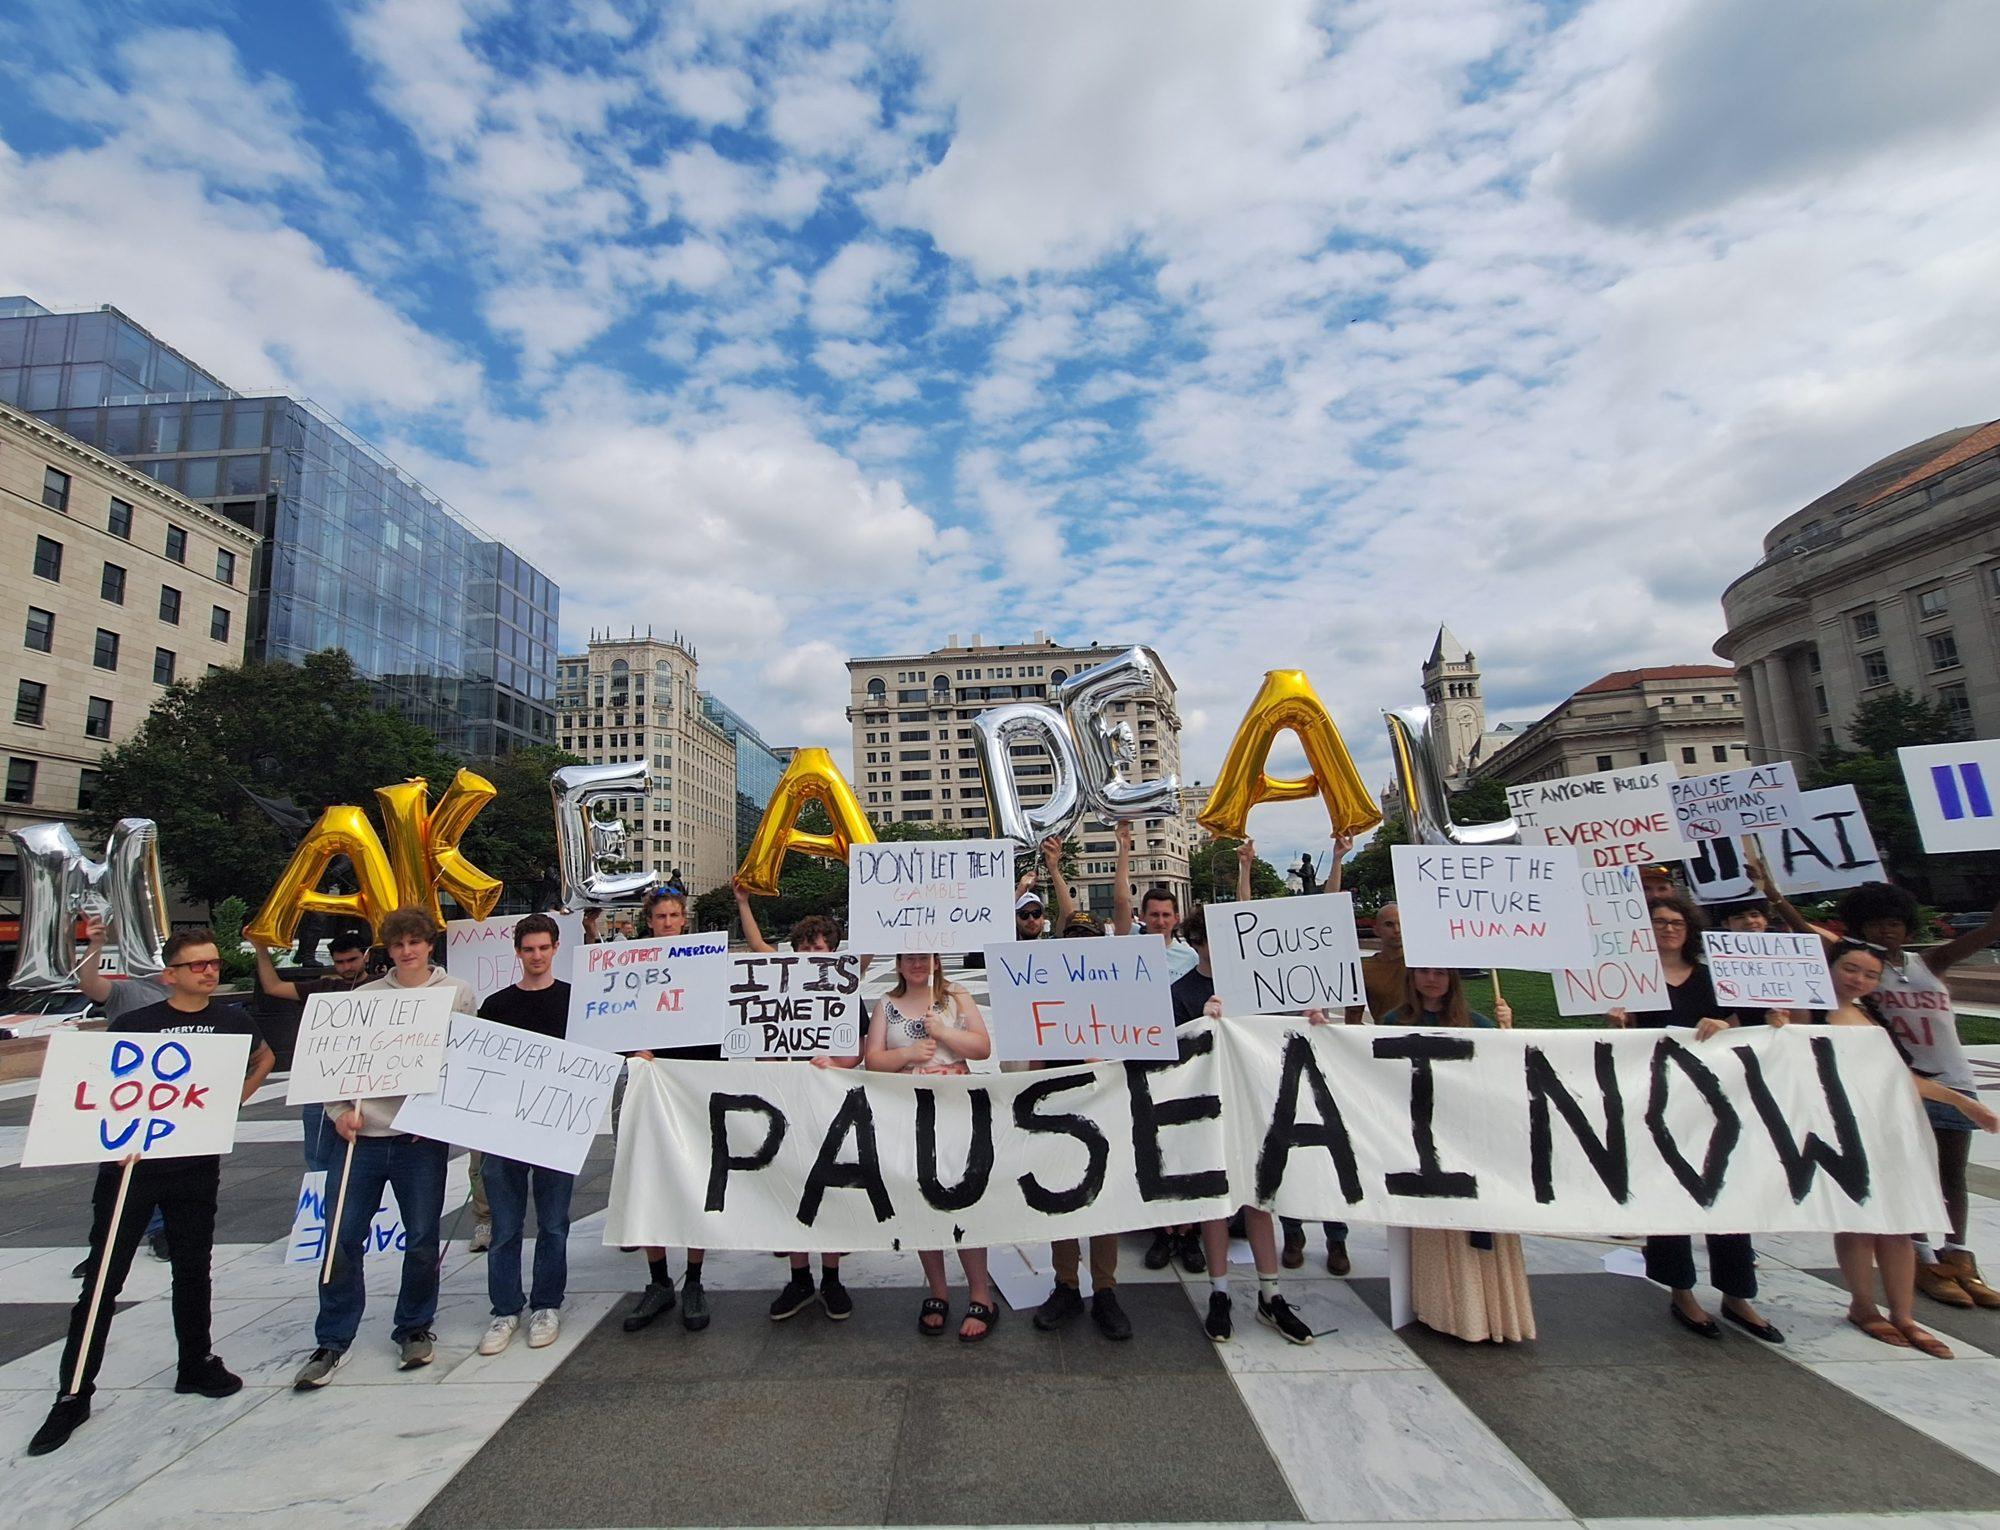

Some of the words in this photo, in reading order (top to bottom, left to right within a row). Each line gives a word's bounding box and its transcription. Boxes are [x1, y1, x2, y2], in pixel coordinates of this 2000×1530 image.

[1508, 788, 1535, 808] IF
[1541, 780, 1607, 804] ANYONE
[1613, 773, 1659, 792] BUILDS
[1671, 775, 1733, 804] PAUSE
[1748, 767, 1784, 788] AI
[1676, 803, 1702, 821] OR
[1706, 791, 1765, 814] HUMANS
[1544, 812, 1669, 846] EVERYONE
[1593, 841, 1654, 867] DIES
[1782, 811, 1880, 877] AI
[858, 847, 925, 884] DON'T
[931, 851, 958, 880] LET
[967, 850, 1005, 878] THEM
[1417, 856, 1494, 882] KEEP
[1505, 856, 1555, 882] THE
[893, 882, 968, 901] GAMBLE
[1438, 886, 1541, 914] FUTURE
[877, 907, 935, 928] WITH
[950, 907, 991, 923] OUR
[1607, 898, 1643, 922] TO
[452, 925, 517, 946] MAK
[904, 931, 960, 950] LIVES
[1234, 912, 1333, 960] Pause
[1450, 918, 1546, 940] HUMAN
[589, 947, 662, 972] PROTECT
[668, 945, 725, 958] AMERICAN
[1706, 934, 1815, 956] REGULATE
[603, 968, 672, 996] JOBS
[730, 957, 799, 993] IT
[803, 955, 859, 994] IS
[1000, 954, 1048, 986] We
[1062, 953, 1119, 982] Want
[1135, 955, 1152, 982] A
[1565, 960, 1658, 1002] NOW
[1713, 961, 1767, 977] BEFORE
[1797, 962, 1825, 977] TOO
[1253, 962, 1358, 1008] NOW!
[389, 998, 426, 1026] LET
[586, 1000, 636, 1019] FROM
[728, 995, 813, 1025] TIME
[1032, 1001, 1161, 1046] Future
[161, 1025, 195, 1034] EVERY
[197, 1025, 216, 1033] DAY
[307, 1035, 361, 1055] THEM
[370, 1030, 441, 1051] GAMBLE
[763, 1024, 832, 1053] PAUSE
[446, 1019, 552, 1070] WHOEVER
[111, 1040, 192, 1081] DO
[320, 1052, 374, 1077] WITH
[386, 1054, 423, 1070] OUR
[75, 1080, 210, 1112] LOOK
[339, 1072, 402, 1095] LIVES
[514, 1079, 598, 1136] WINS
[100, 1118, 176, 1152] UP
[704, 1030, 1229, 1227] PAUSE
[1255, 1029, 1478, 1212] AI
[1525, 1036, 1870, 1209] NOW
